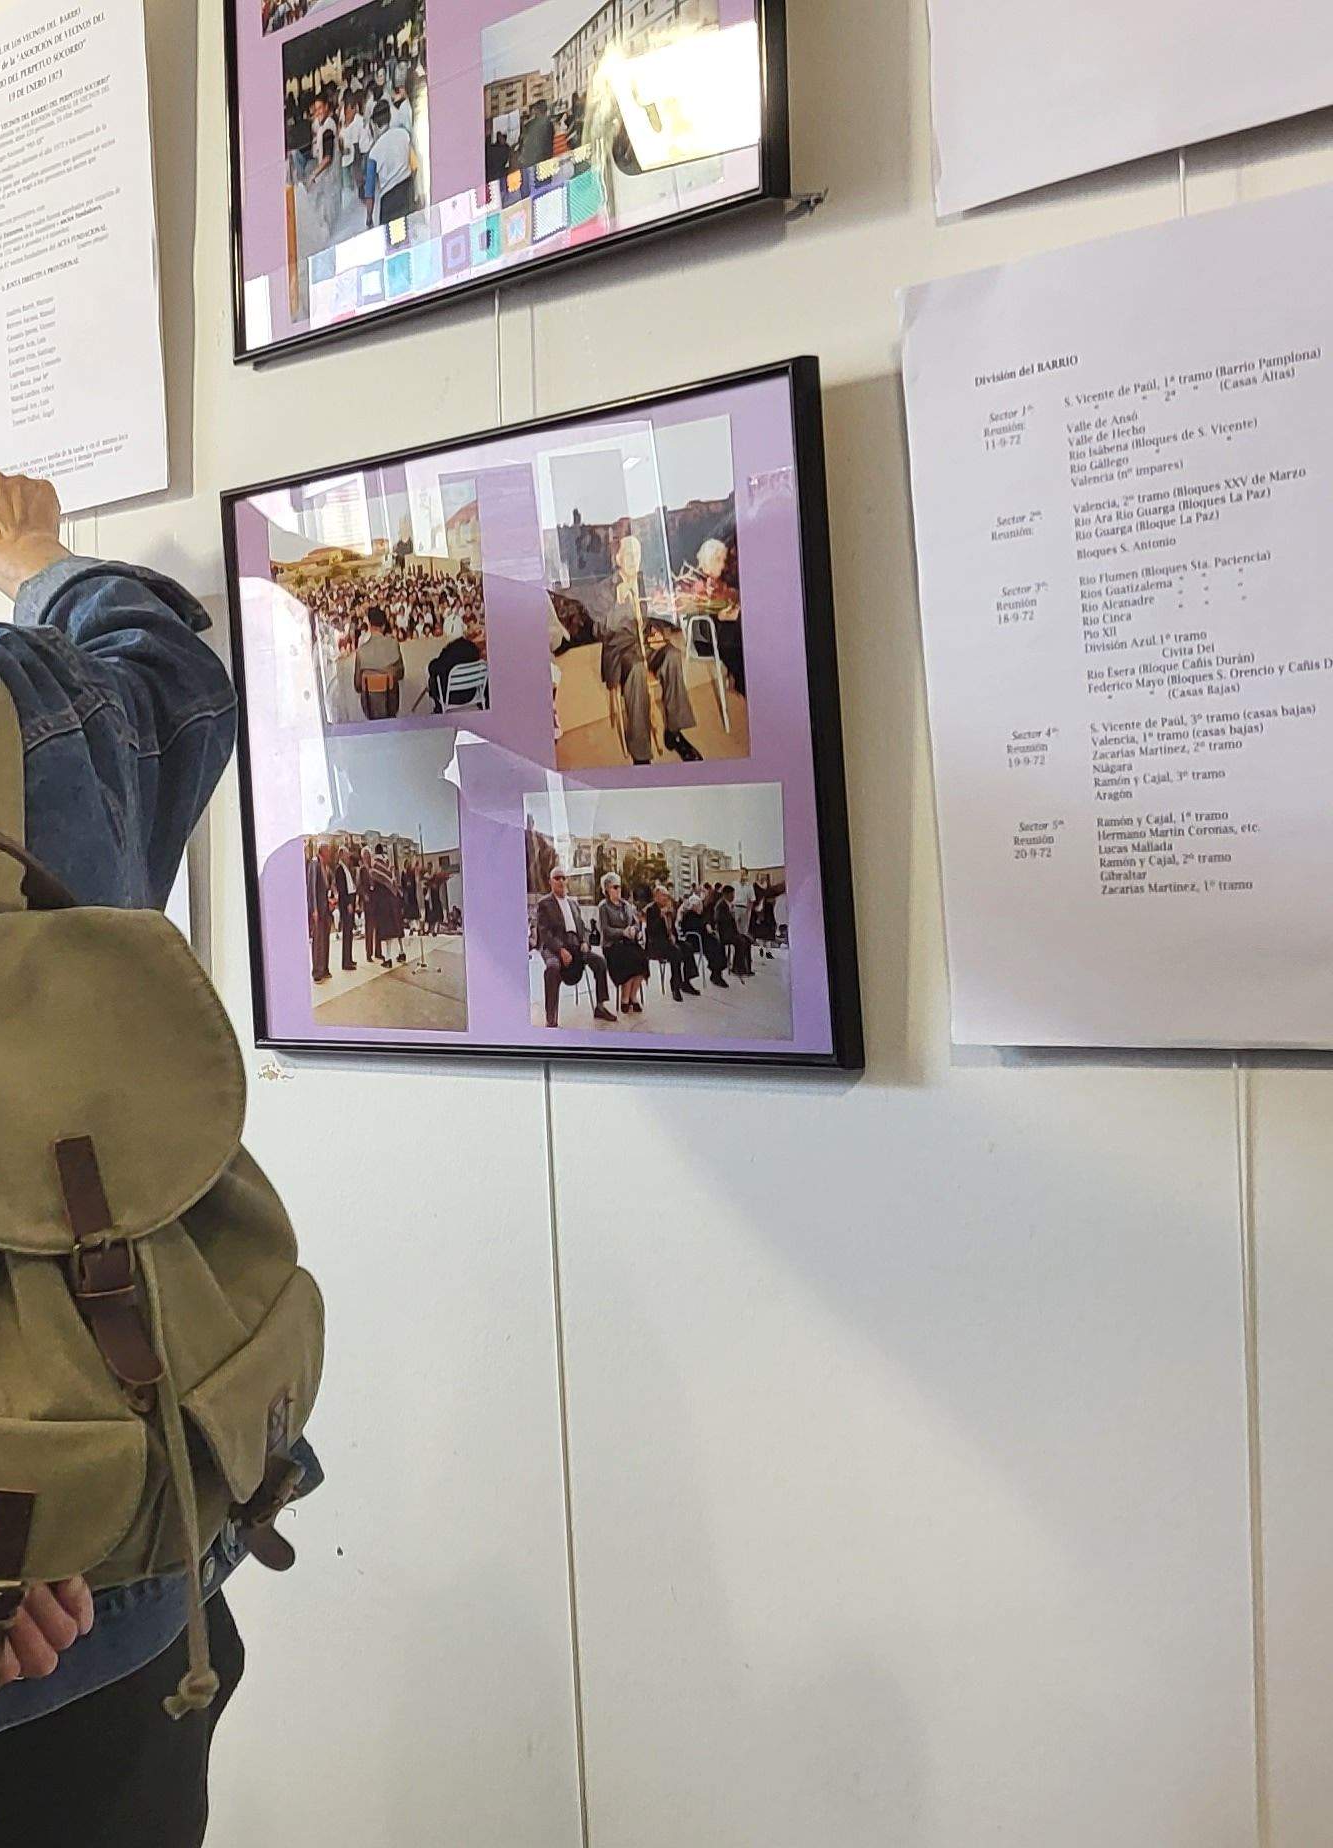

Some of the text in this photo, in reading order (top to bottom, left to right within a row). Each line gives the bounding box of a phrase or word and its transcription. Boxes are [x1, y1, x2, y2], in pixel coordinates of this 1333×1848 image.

[47, 19, 56, 30] DEL
[60, 7, 80, 24] BARRIO
[64, 20, 91, 38] VECINOS
[93, 12, 105, 24] DEL
[8, 73, 18, 84] DEL
[21, 57, 51, 78] PERPETUO
[27, 77, 46, 94] ENERO
[975, 355, 1078, 387] División del BARRIO
[1065, 398, 1073, 407] S.
[1076, 390, 1114, 404] Vicente
[1118, 385, 1131, 397] de
[1179, 370, 1212, 385] tramo
[1215, 363, 1255, 378] (Barrio
[1259, 348, 1322, 367] Pamplona)
[1220, 368, 1296, 392] (Casas Altas)
[989, 409, 1017, 423] Sector
[1066, 422, 1091, 433] Valle
[1095, 417, 1107, 428] de
[1067, 424, 1145, 447] Valle de Hecho
[1132, 433, 1178, 449] (Bloques
[1181, 430, 1194, 441] de
[1211, 418, 1258, 435] Vicente)
[1071, 472, 1113, 487] Valencia
[1136, 460, 1183, 477] impares)
[1138, 491, 1170, 503] tramo
[1173, 484, 1221, 499] (Bloques
[1224, 477, 1249, 490] XXV
[1252, 474, 1266, 485] de
[1270, 468, 1306, 482] Marzo
[1095, 488, 1271, 524] Ara Guarga (Bloques La Paz)
[996, 515, 1025, 527] Sector
[1095, 510, 1219, 539] Guarga (Bloque La Paz)
[1077, 545, 1117, 560] Bloques
[1133, 537, 1176, 551] Antonio
[1099, 571, 1138, 583] Flumen
[1141, 562, 1187, 578] (Bloques
[1214, 550, 1271, 568] Paciencia)
[1002, 584, 1031, 597] Sector
[1105, 578, 1172, 597] Guatizalema
[1102, 596, 1155, 610] Alcanadre
[1103, 612, 1131, 623] Cinca
[1103, 626, 1116, 637] XII
[1085, 630, 1207, 653] División tramo
[1162, 647, 1193, 658] Civita
[1139, 663, 1178, 675] (Bloque
[1216, 653, 1255, 665] Durán)
[1088, 682, 1132, 694] Federico
[1135, 678, 1163, 688] Mayo
[1167, 672, 1213, 685] (Bloques
[1217, 671, 1226, 681] S.
[1230, 665, 1274, 678] Orencio
[1288, 660, 1320, 673] Cañis
[1168, 683, 1240, 699] (Casas Bajas)
[1102, 720, 1141, 732] Vicente
[1145, 718, 1157, 728] de
[1206, 712, 1240, 723] tramo
[1243, 708, 1278, 720] (casas
[1281, 704, 1316, 717] bajas)
[1157, 731, 1189, 741] tramo
[1193, 727, 1225, 738] (casas
[1229, 723, 1263, 736] bajas)
[1209, 740, 1242, 751] tramo
[1192, 769, 1225, 780] tramo
[1195, 811, 1228, 822] tramo
[1098, 830, 1146, 841] Hermano
[1241, 824, 1260, 833] etc.
[1098, 841, 1172, 854] Lucas Mallada
[1198, 853, 1231, 863] tramo
[1101, 871, 1147, 881] Gibraltar
[1219, 880, 1253, 891] tramo
